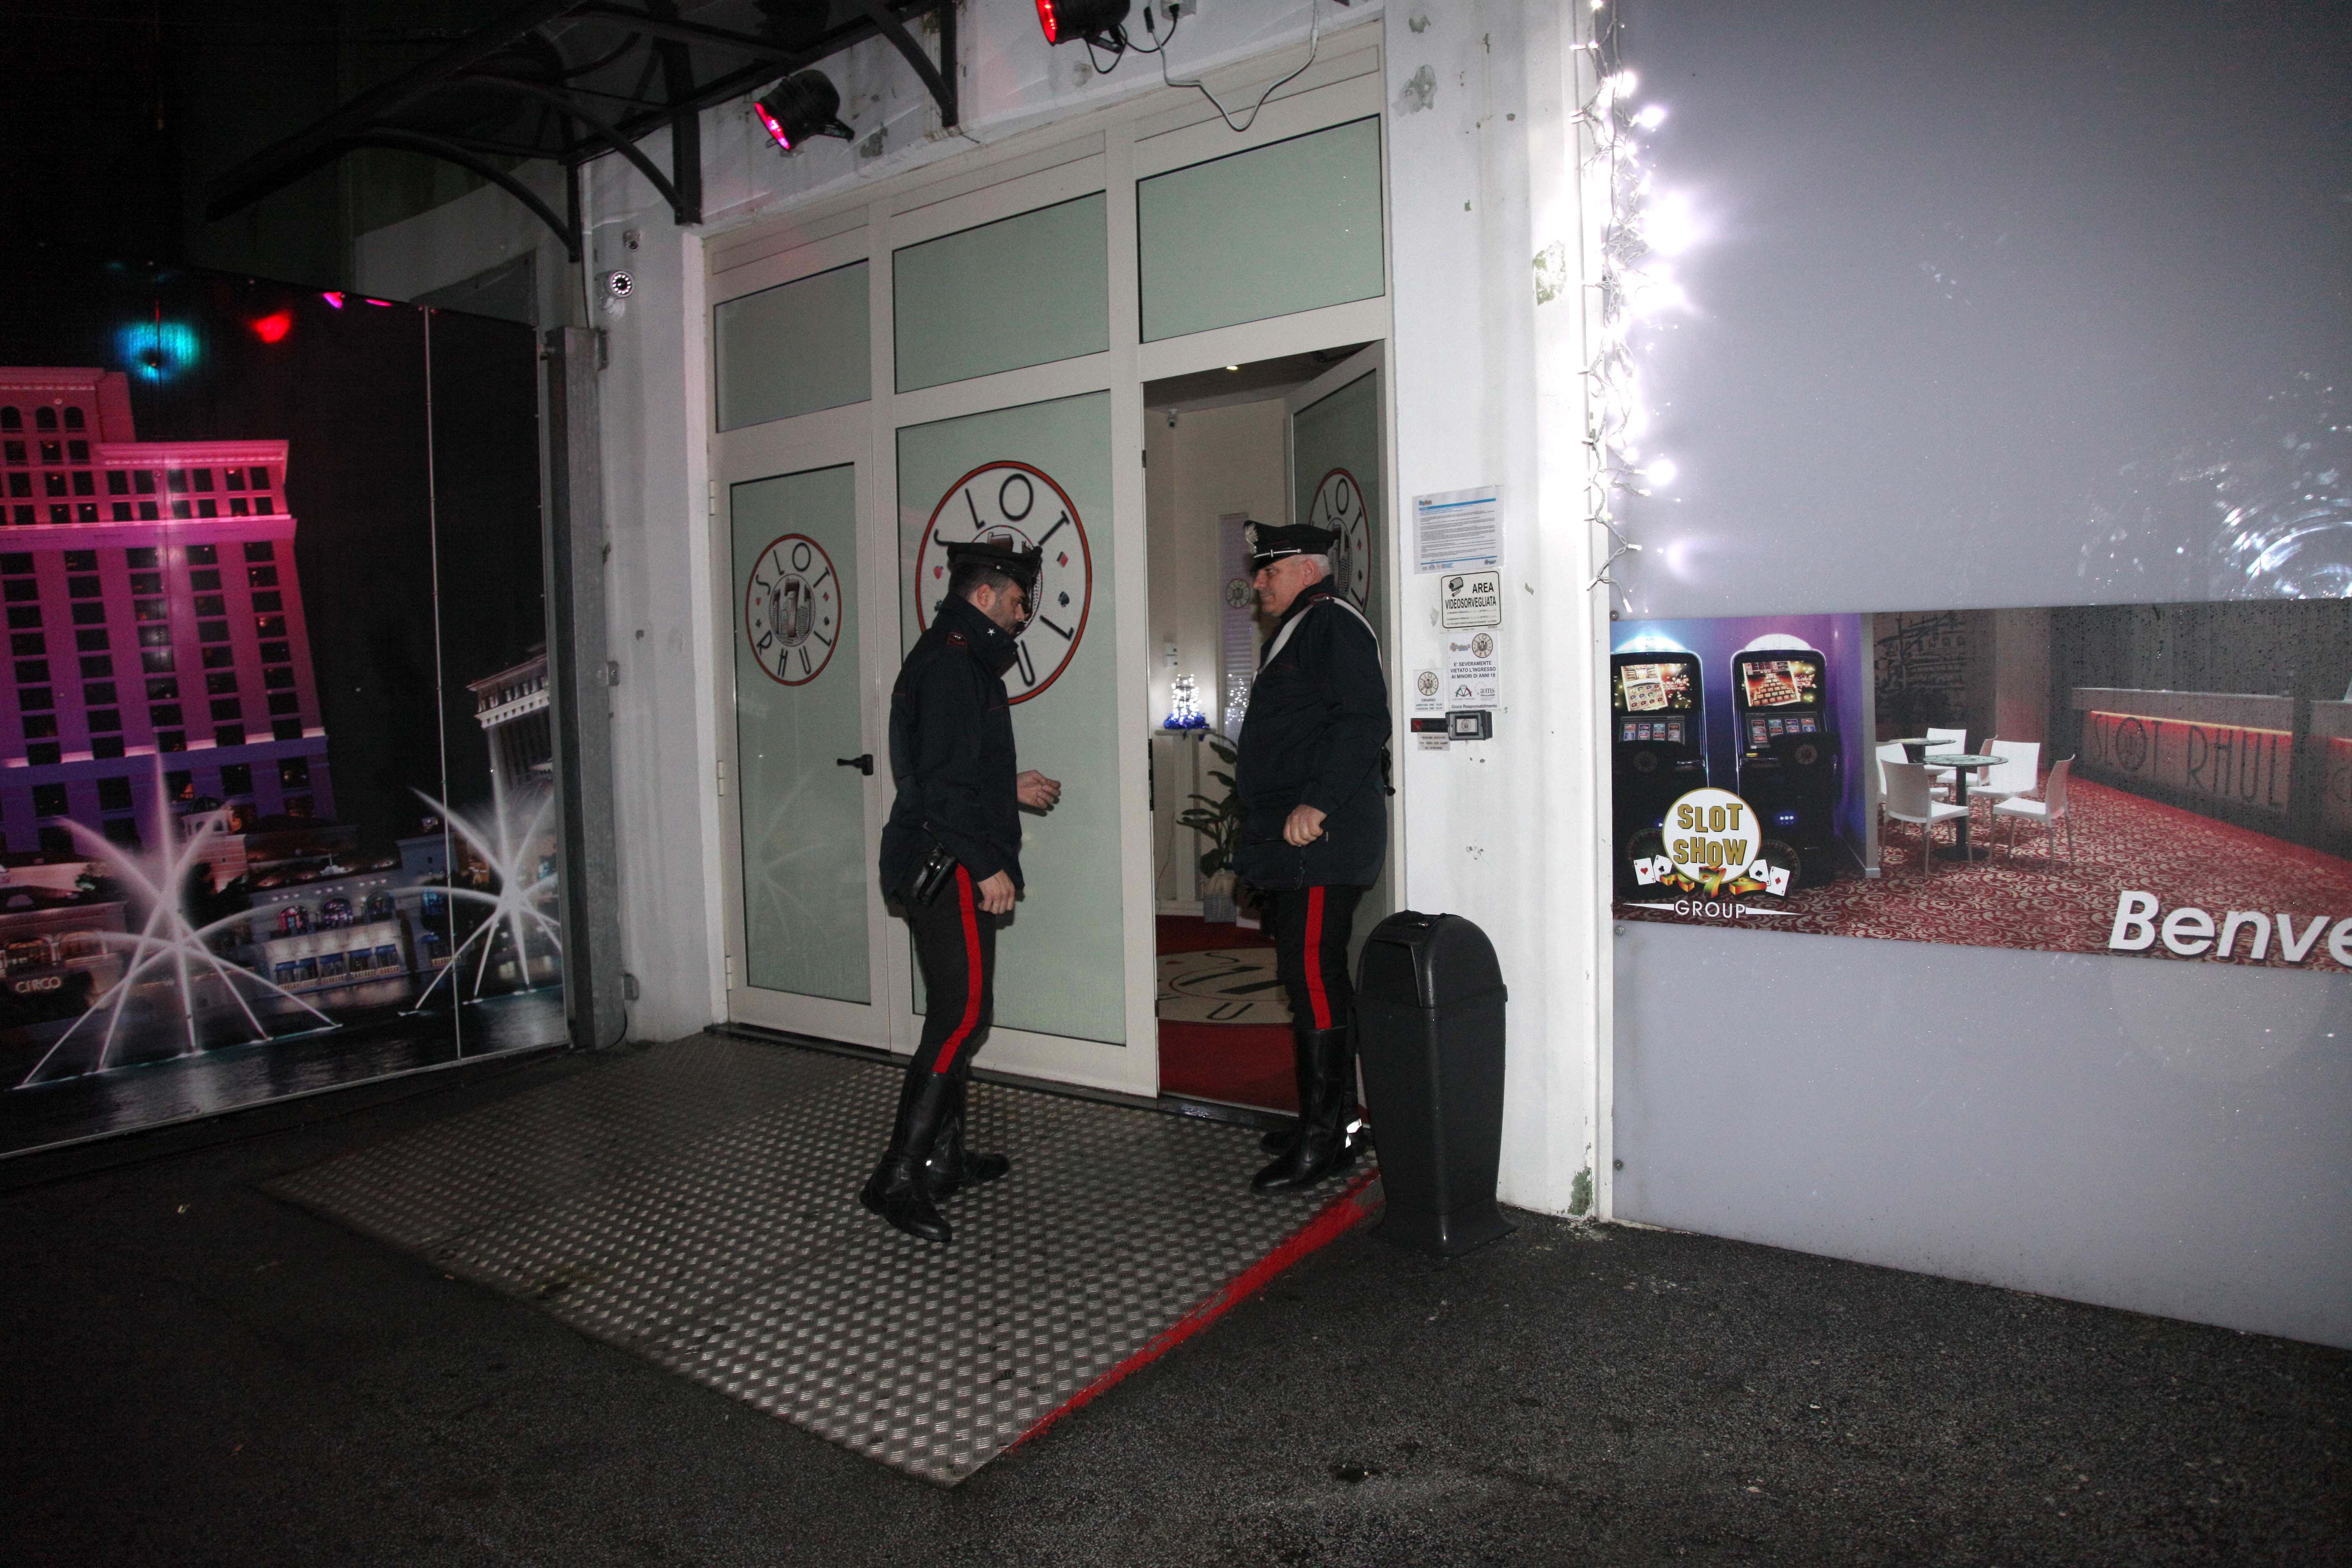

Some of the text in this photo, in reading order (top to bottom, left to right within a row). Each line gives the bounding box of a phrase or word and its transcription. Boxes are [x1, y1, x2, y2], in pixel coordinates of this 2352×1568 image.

[756, 542, 830, 595] SLOT
[1472, 582, 1494, 594] AREA
[1445, 596, 1496, 610] VIDEOSORVEGLIATA
[756, 629, 833, 678] RHUL
[1677, 803, 1743, 833] SLOT
[1673, 837, 1747, 867] SHOW
[1675, 900, 1746, 919] GROUP
[15, 976, 62, 993] CIRCO
